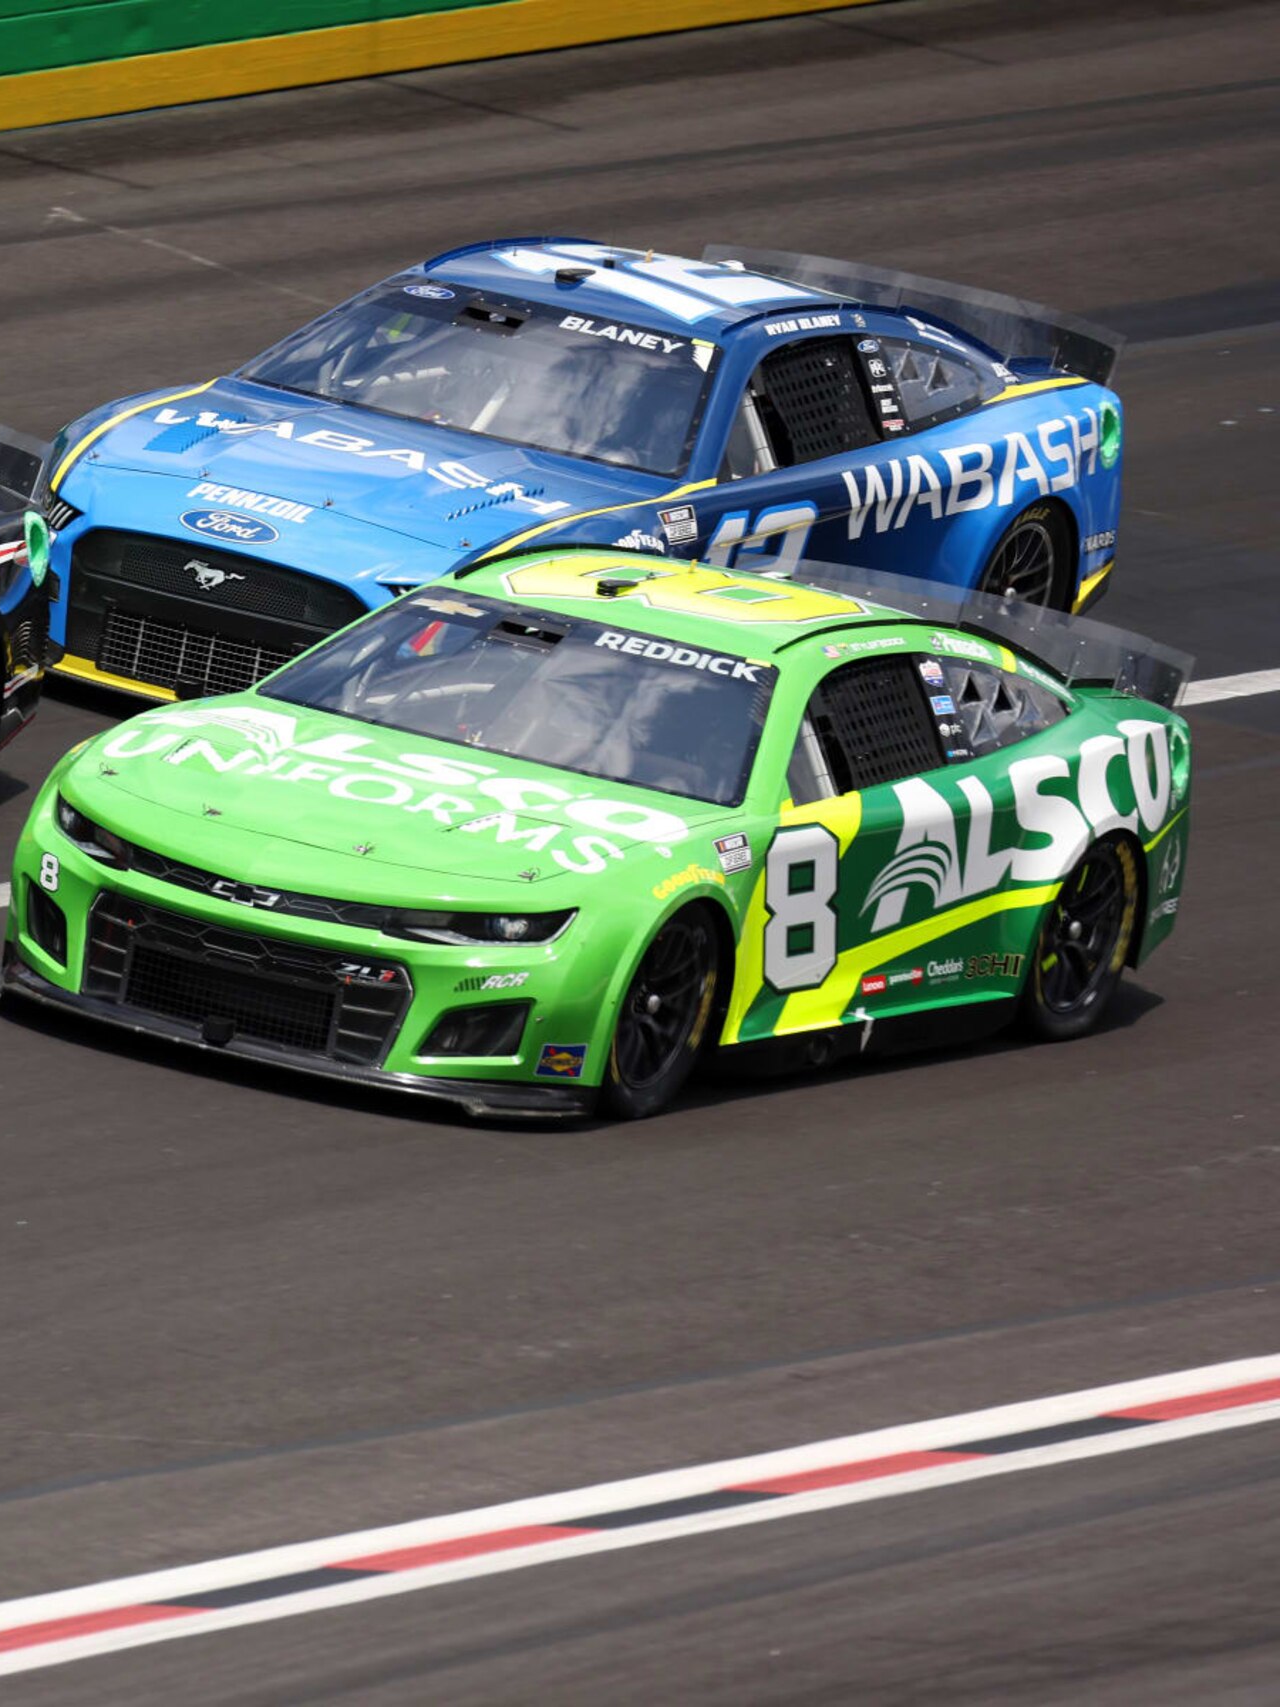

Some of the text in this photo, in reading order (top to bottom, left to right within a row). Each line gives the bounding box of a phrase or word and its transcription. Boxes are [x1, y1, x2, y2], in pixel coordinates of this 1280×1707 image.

[558, 315, 685, 354] BLANEY
[153, 407, 570, 514] WABASH
[843, 406, 1099, 542] WABASH
[187, 482, 315, 524] PENNZOIL
[195, 511, 263, 539] Ford
[594, 630, 766, 684] REDDICK
[102, 729, 626, 875] UNIFORMS
[138, 706, 693, 844] ALSCO
[857, 719, 1170, 933] ALSCO
[39, 853, 60, 892] 8
[763, 824, 839, 991] 8
[336, 961, 397, 983] ZL1
[480, 971, 529, 990] RCR
